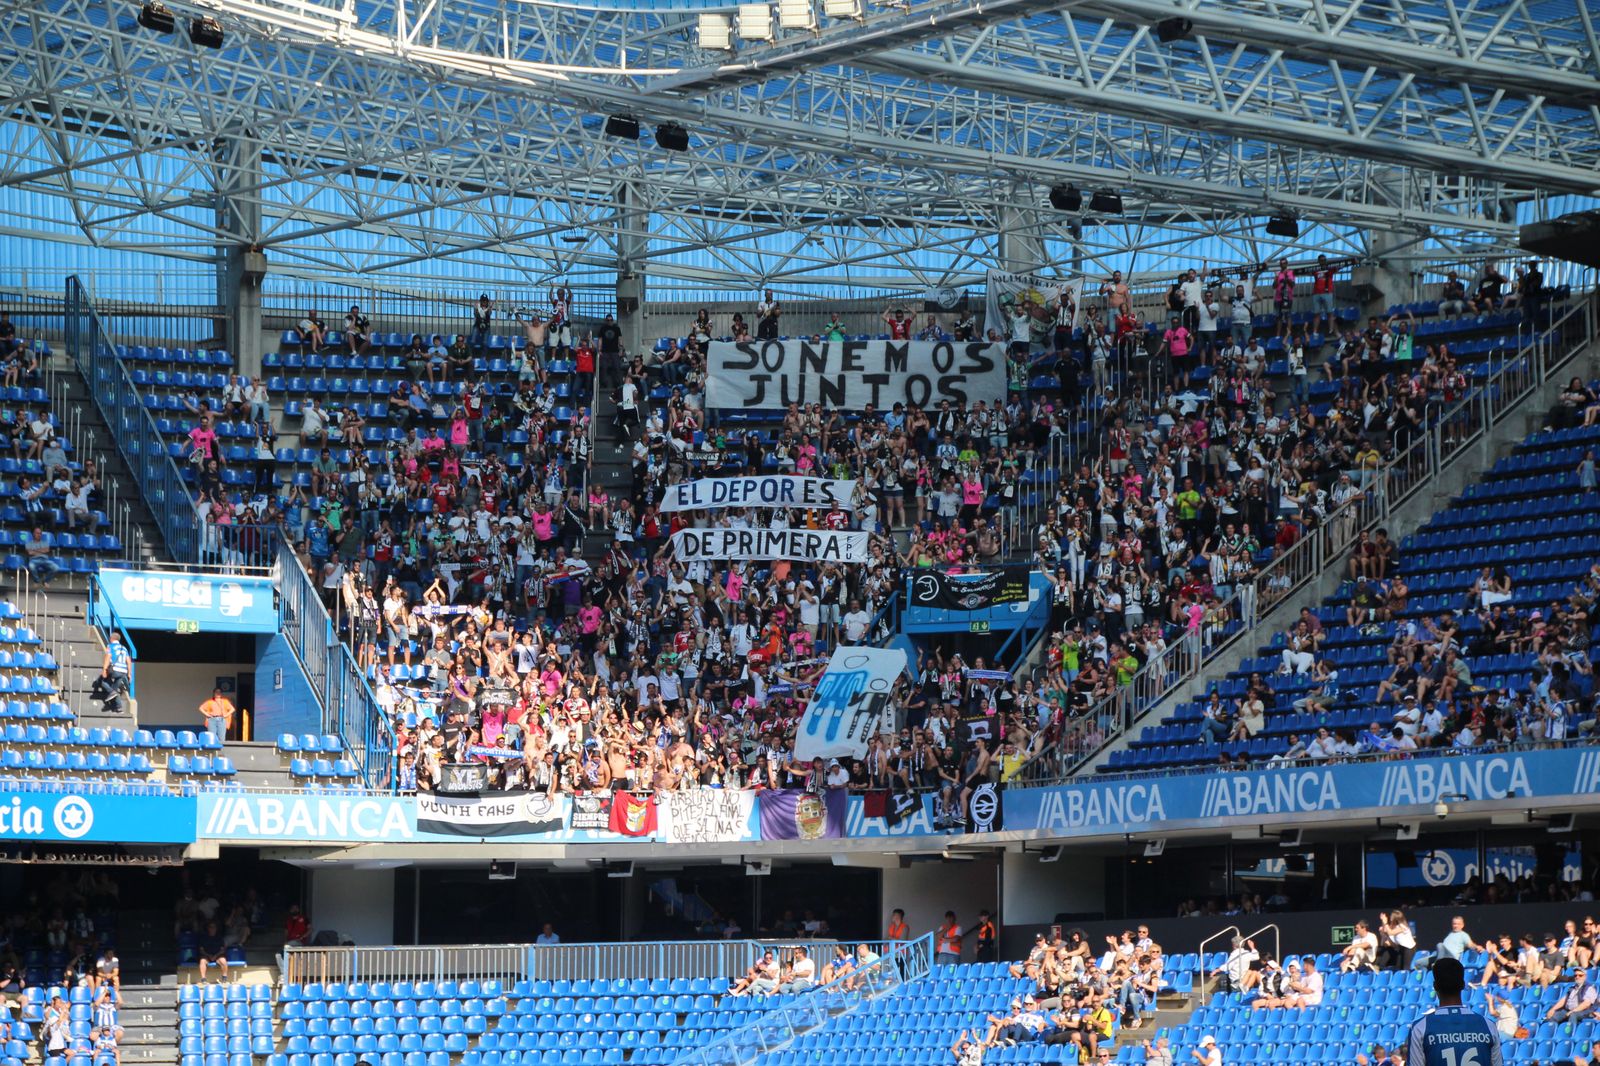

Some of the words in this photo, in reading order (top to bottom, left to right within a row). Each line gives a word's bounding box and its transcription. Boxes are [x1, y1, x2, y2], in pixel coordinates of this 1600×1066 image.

[743, 374, 967, 408] JUNTOS
[677, 483, 703, 506] EL
[711, 478, 795, 504] DEPOR
[803, 479, 835, 504] ES
[683, 531, 715, 557] DE
[722, 530, 841, 560] PRIMERA
[121, 576, 212, 605] asisa
[1213, 770, 1341, 816] ABANCA
[1393, 757, 1533, 806] ABANCA
[478, 803, 515, 818] FANS
[721, 789, 740, 806] NO
[1050, 784, 1166, 829] ABANCA
[233, 797, 413, 838] ABANCA
[573, 812, 610, 822] SIEMPRE
[1428, 1034, 1436, 1045] P.
[1436, 1032, 1491, 1044] TRIGUEROS
[142, 1050, 153, 1058] 11
[1441, 1047, 1482, 1066] 16
